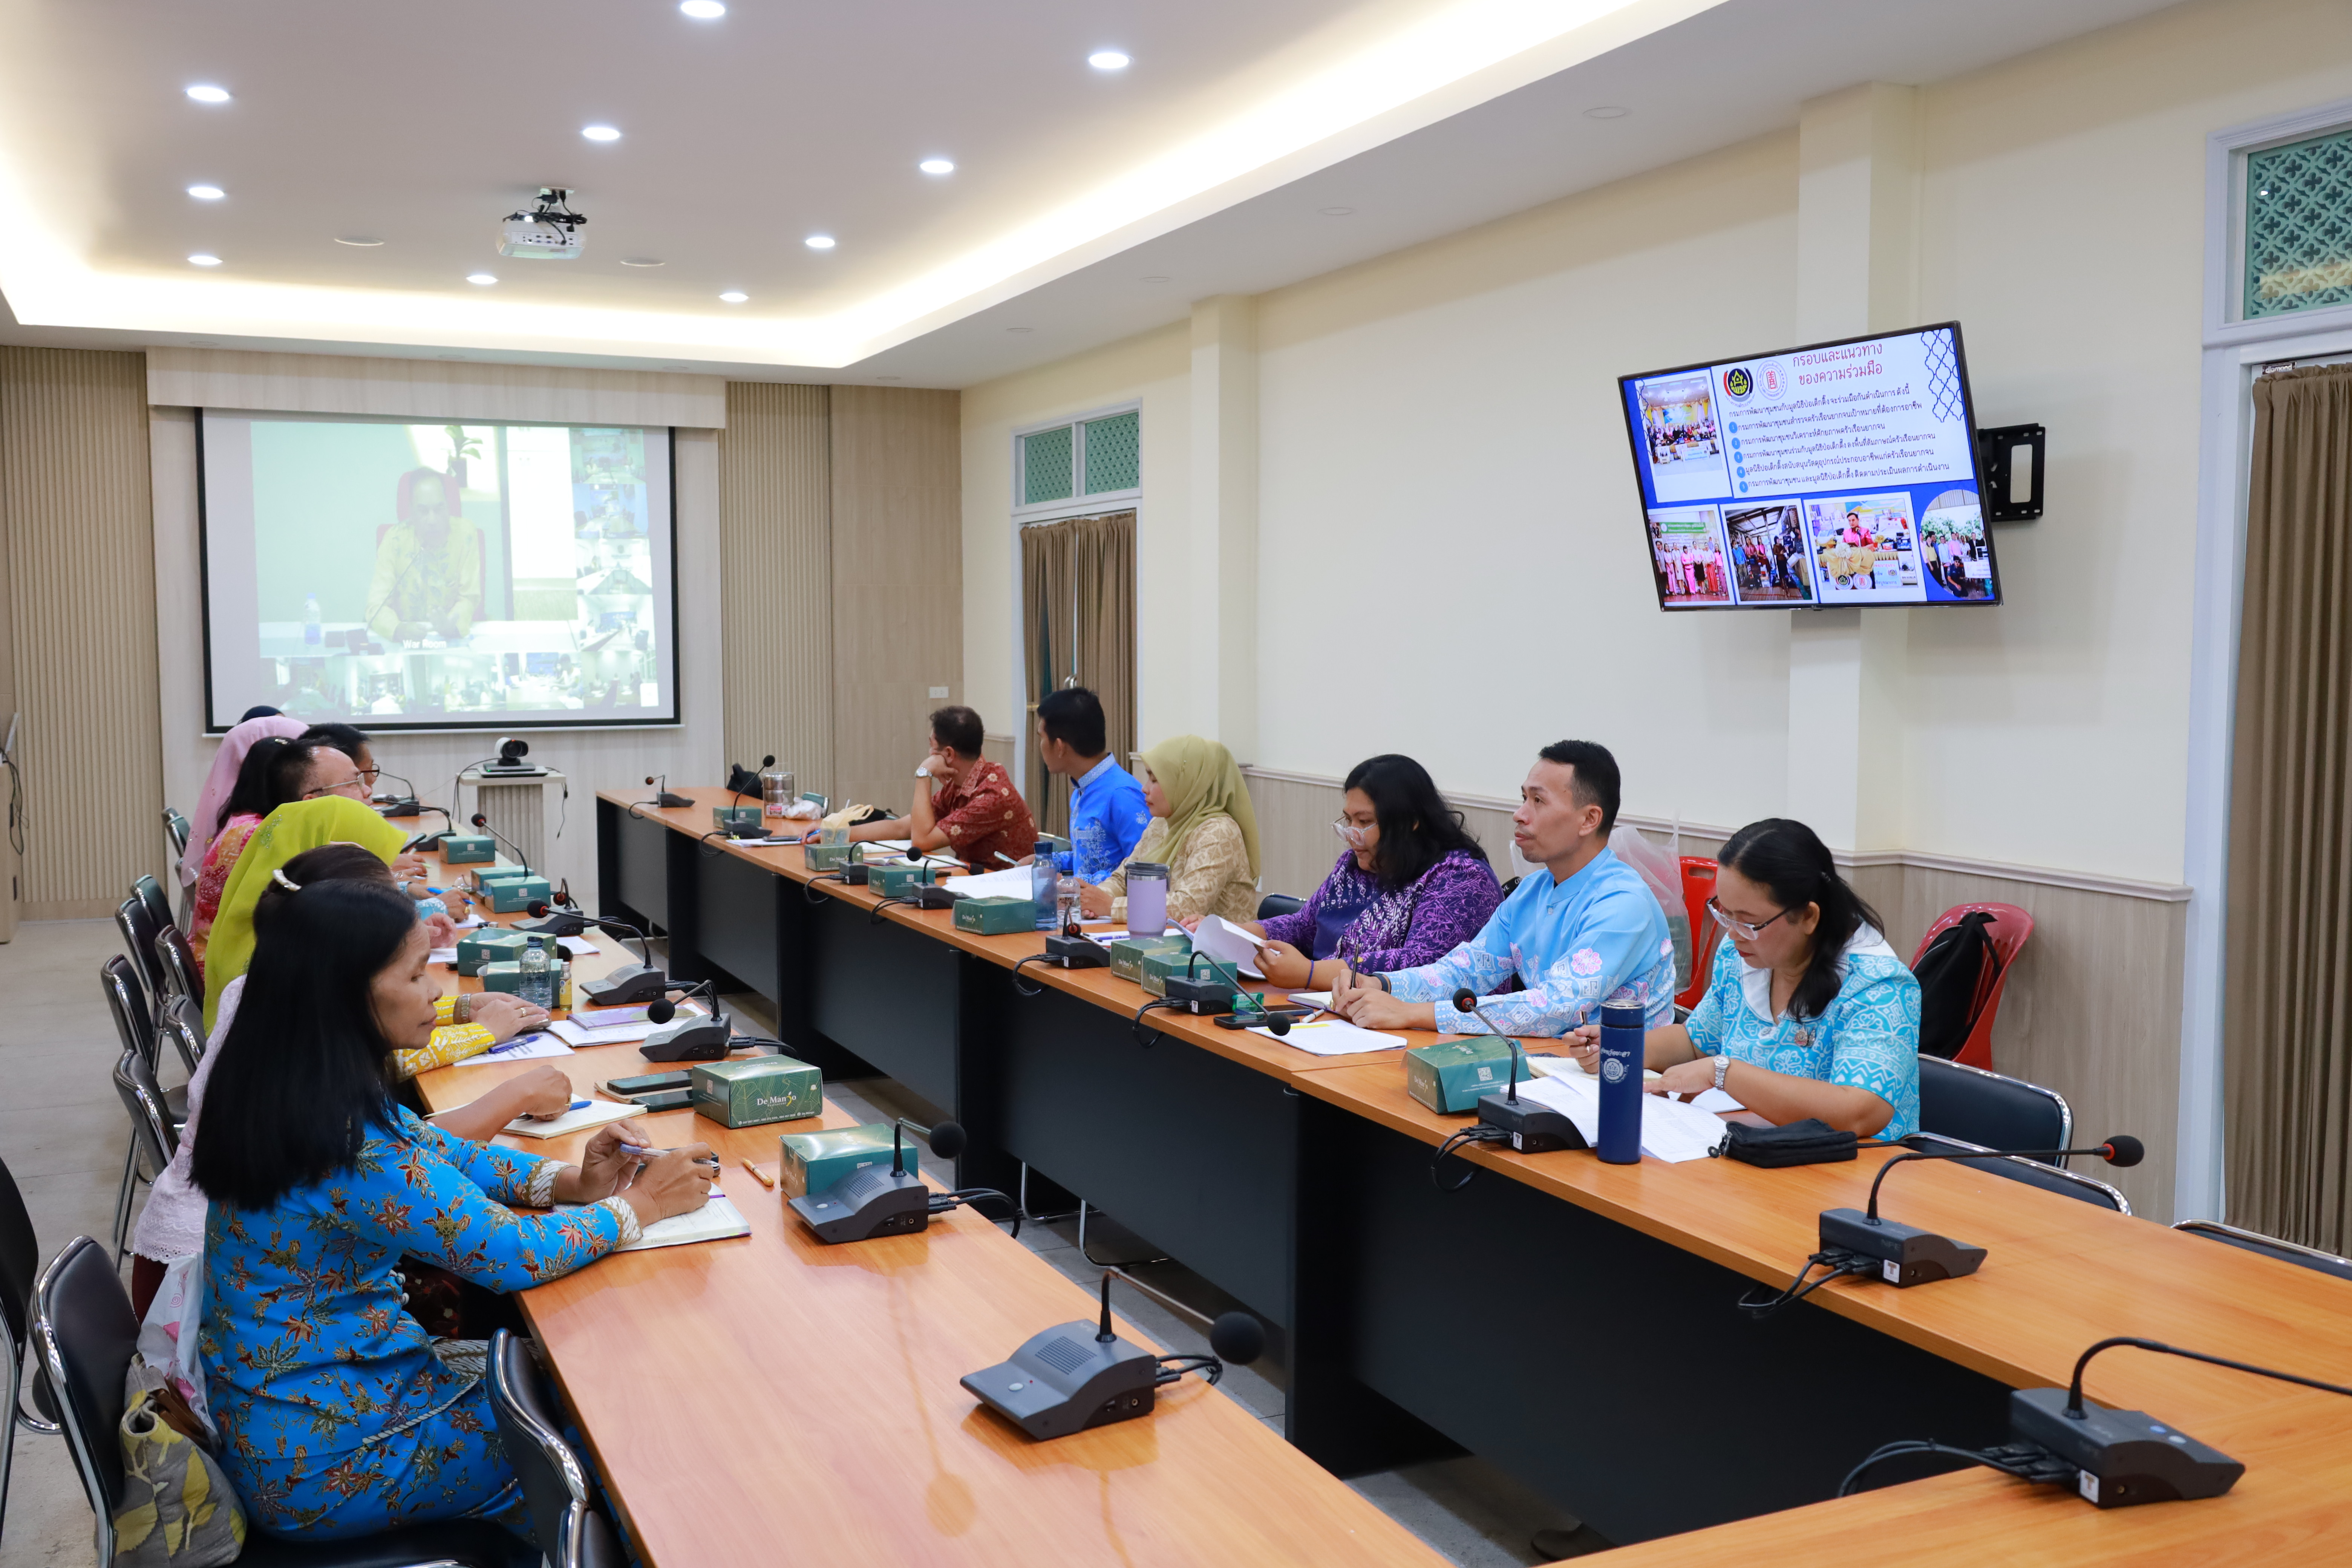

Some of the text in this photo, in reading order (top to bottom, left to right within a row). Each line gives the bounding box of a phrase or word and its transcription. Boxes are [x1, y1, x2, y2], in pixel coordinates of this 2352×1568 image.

[1793, 343, 1883, 368] กรอบและแนวทาง
[1799, 360, 1883, 385] ของความร่วมมือ
[1830, 389, 1895, 404] จะร่วมมือกันดำเนินการ
[1897, 383, 1909, 395] ดังนี้
[1748, 477, 1801, 487] กรมการพัฒนาชุมชน
[403, 639, 446, 648] War Room
[770, 1092, 796, 1107] Mango
[1888, 1262, 1897, 1274] T
